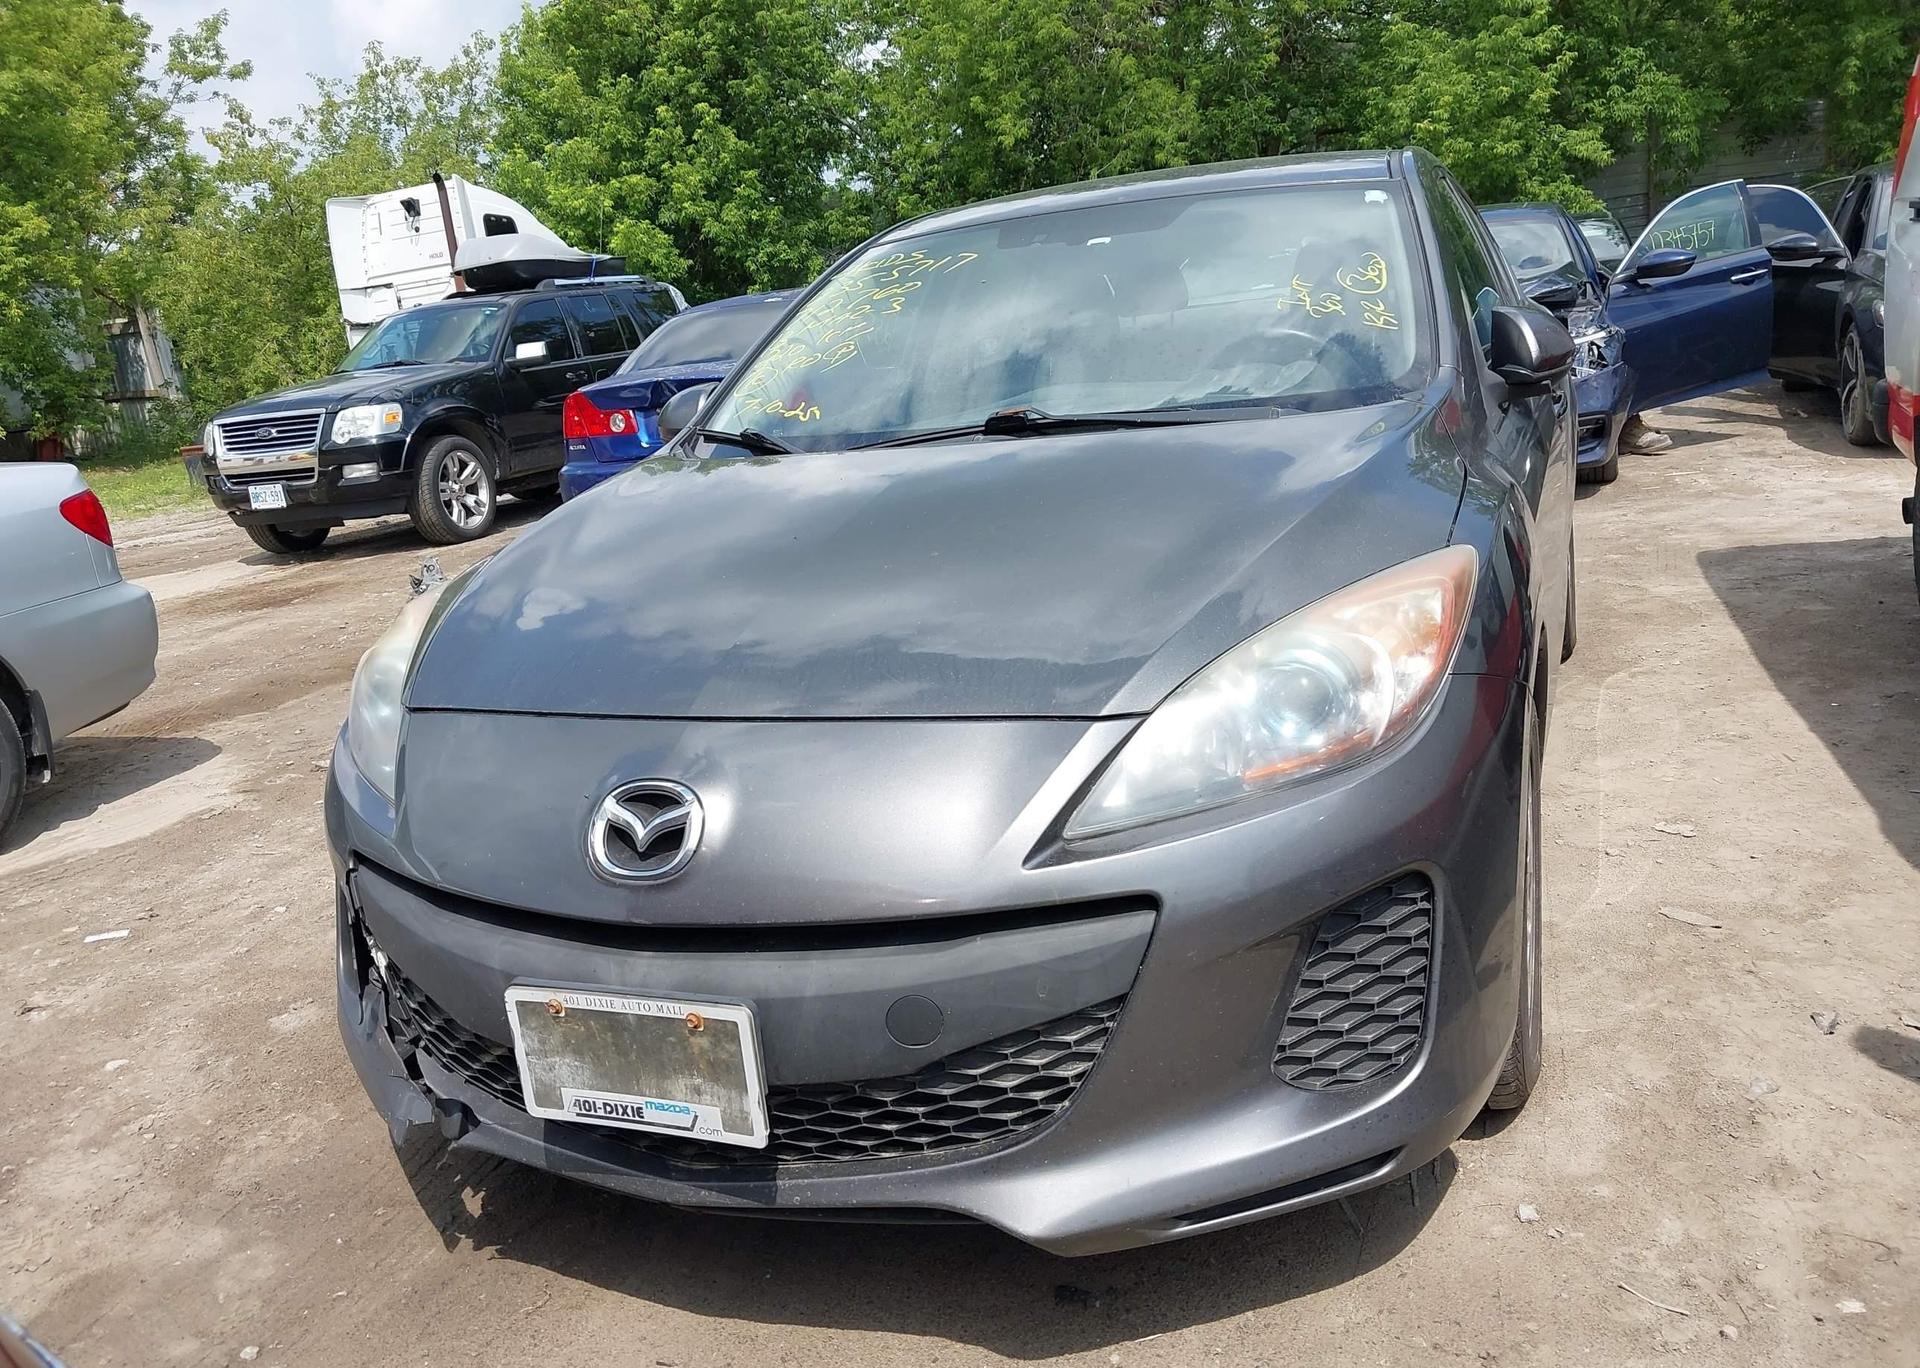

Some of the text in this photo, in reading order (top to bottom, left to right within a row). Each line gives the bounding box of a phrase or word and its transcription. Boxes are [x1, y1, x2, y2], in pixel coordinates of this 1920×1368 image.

[562, 994, 685, 1016] 401 DIXIE AUTO MALL
